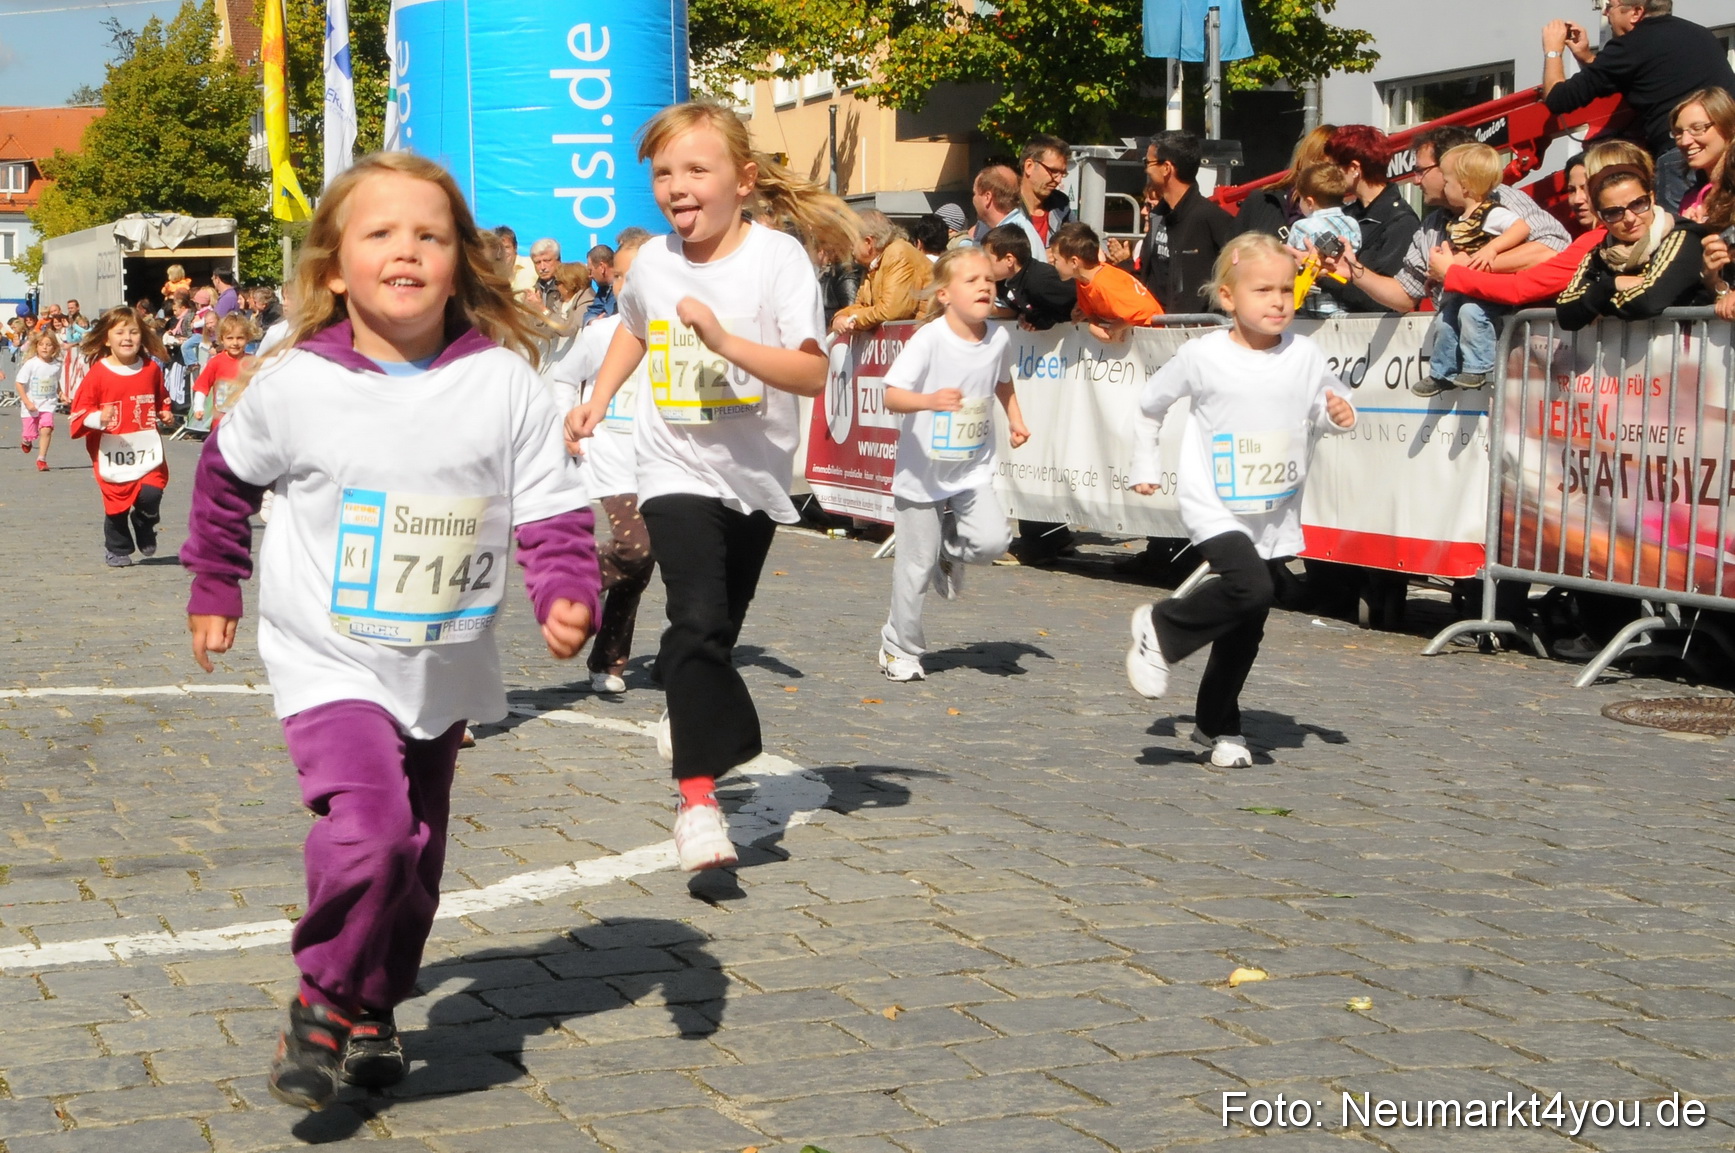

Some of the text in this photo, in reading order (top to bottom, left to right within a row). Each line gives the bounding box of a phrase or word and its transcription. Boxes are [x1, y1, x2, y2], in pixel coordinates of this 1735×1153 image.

[1475, 117, 1506, 143] Junior
[675, 360, 750, 388] 7120
[1017, 345, 1068, 380] Ideen
[1328, 343, 1370, 389] erd
[1626, 374, 1662, 396] FÜS
[956, 420, 989, 439] 7086
[104, 448, 155, 467] 10371
[1238, 439, 1261, 454] Ella
[1242, 461, 1298, 485] 7228
[393, 505, 477, 536] Samina
[393, 551, 495, 595] 7142
[350, 621, 399, 636] BOCK
